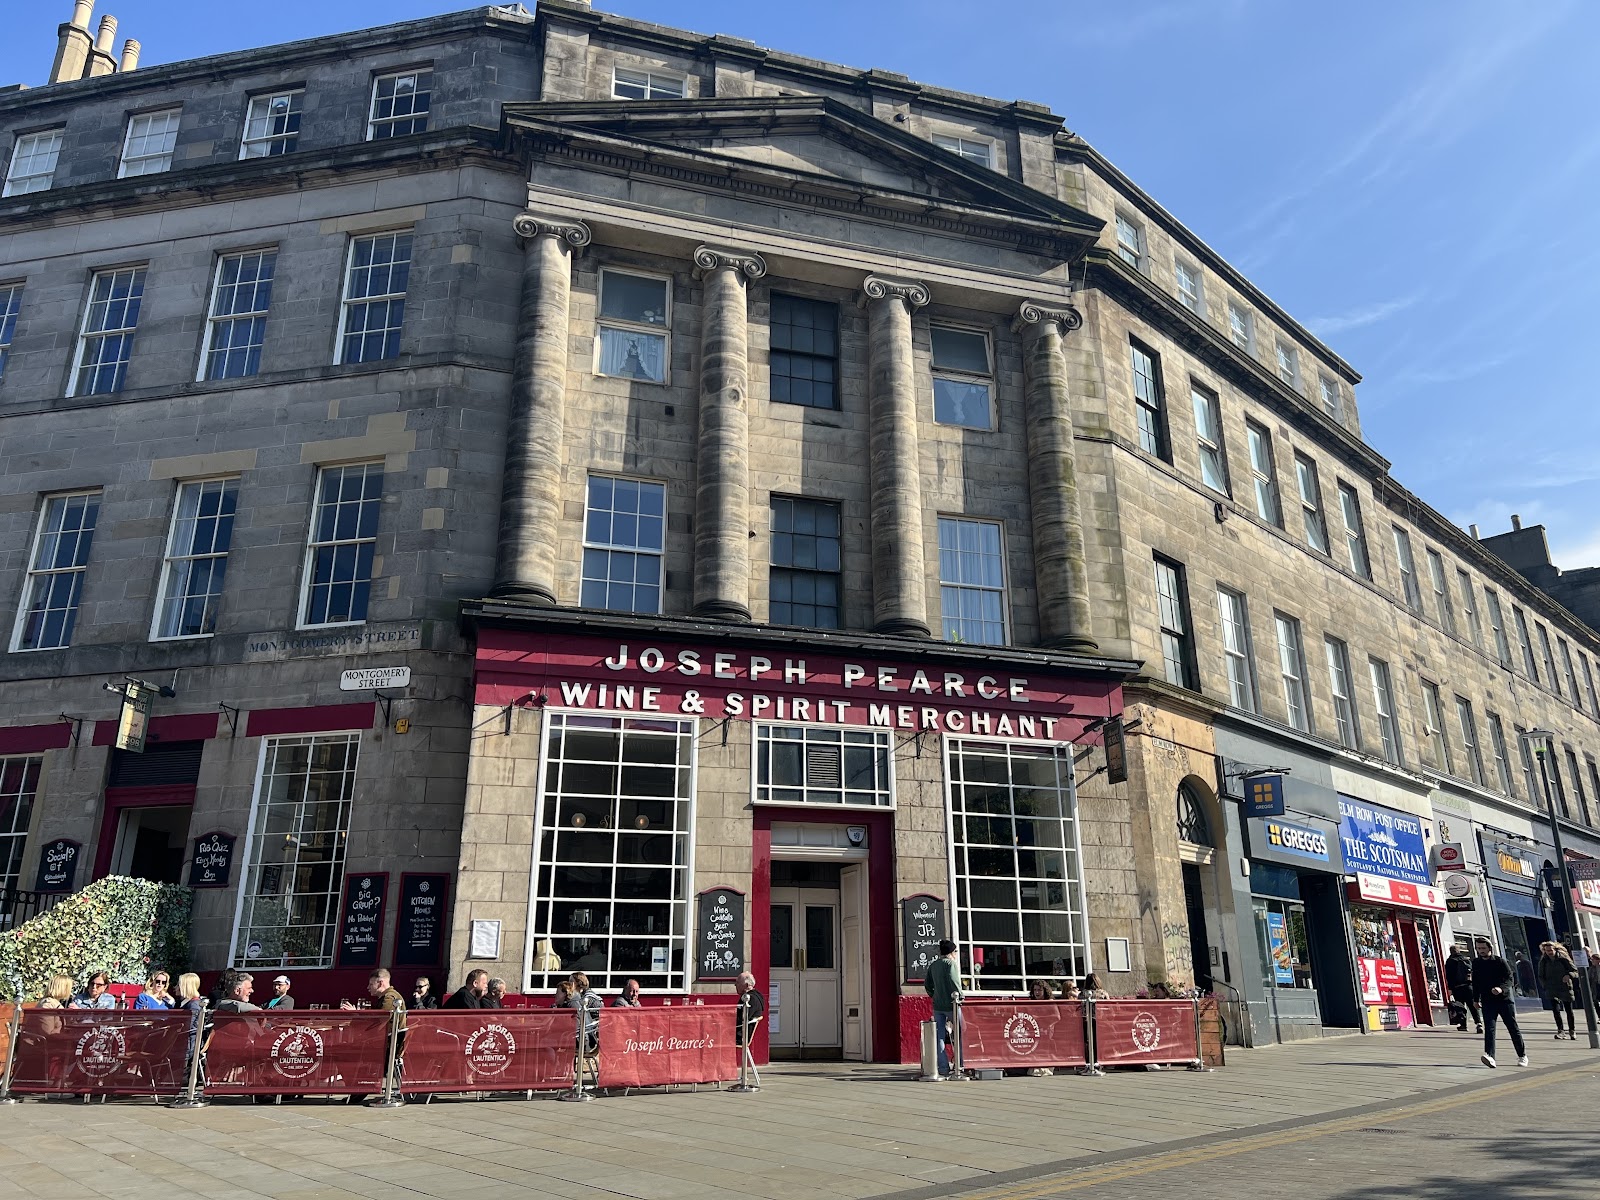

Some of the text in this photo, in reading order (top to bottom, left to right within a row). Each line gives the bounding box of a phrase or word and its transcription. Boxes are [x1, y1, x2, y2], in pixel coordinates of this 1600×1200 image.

[344, 668, 407, 680] MONTGOMERY
[358, 678, 391, 688] STREET
[605, 645, 1030, 702] JOSEPH PEARCE
[560, 681, 1058, 738] WINE & SPIRIT MERCHANT
[1338, 802, 1419, 835] ELM ROW POST OFFICE
[47, 847, 75, 862] Social?
[1281, 827, 1328, 854] GREGGS
[1343, 837, 1425, 873] THE SCOTSMAN
[714, 940, 729, 949] Food
[271, 1025, 324, 1057] BIRRA MORETTI
[465, 1023, 517, 1055] BIRRA MORETTI
[623, 1034, 715, 1055] Joseph Pearce's
